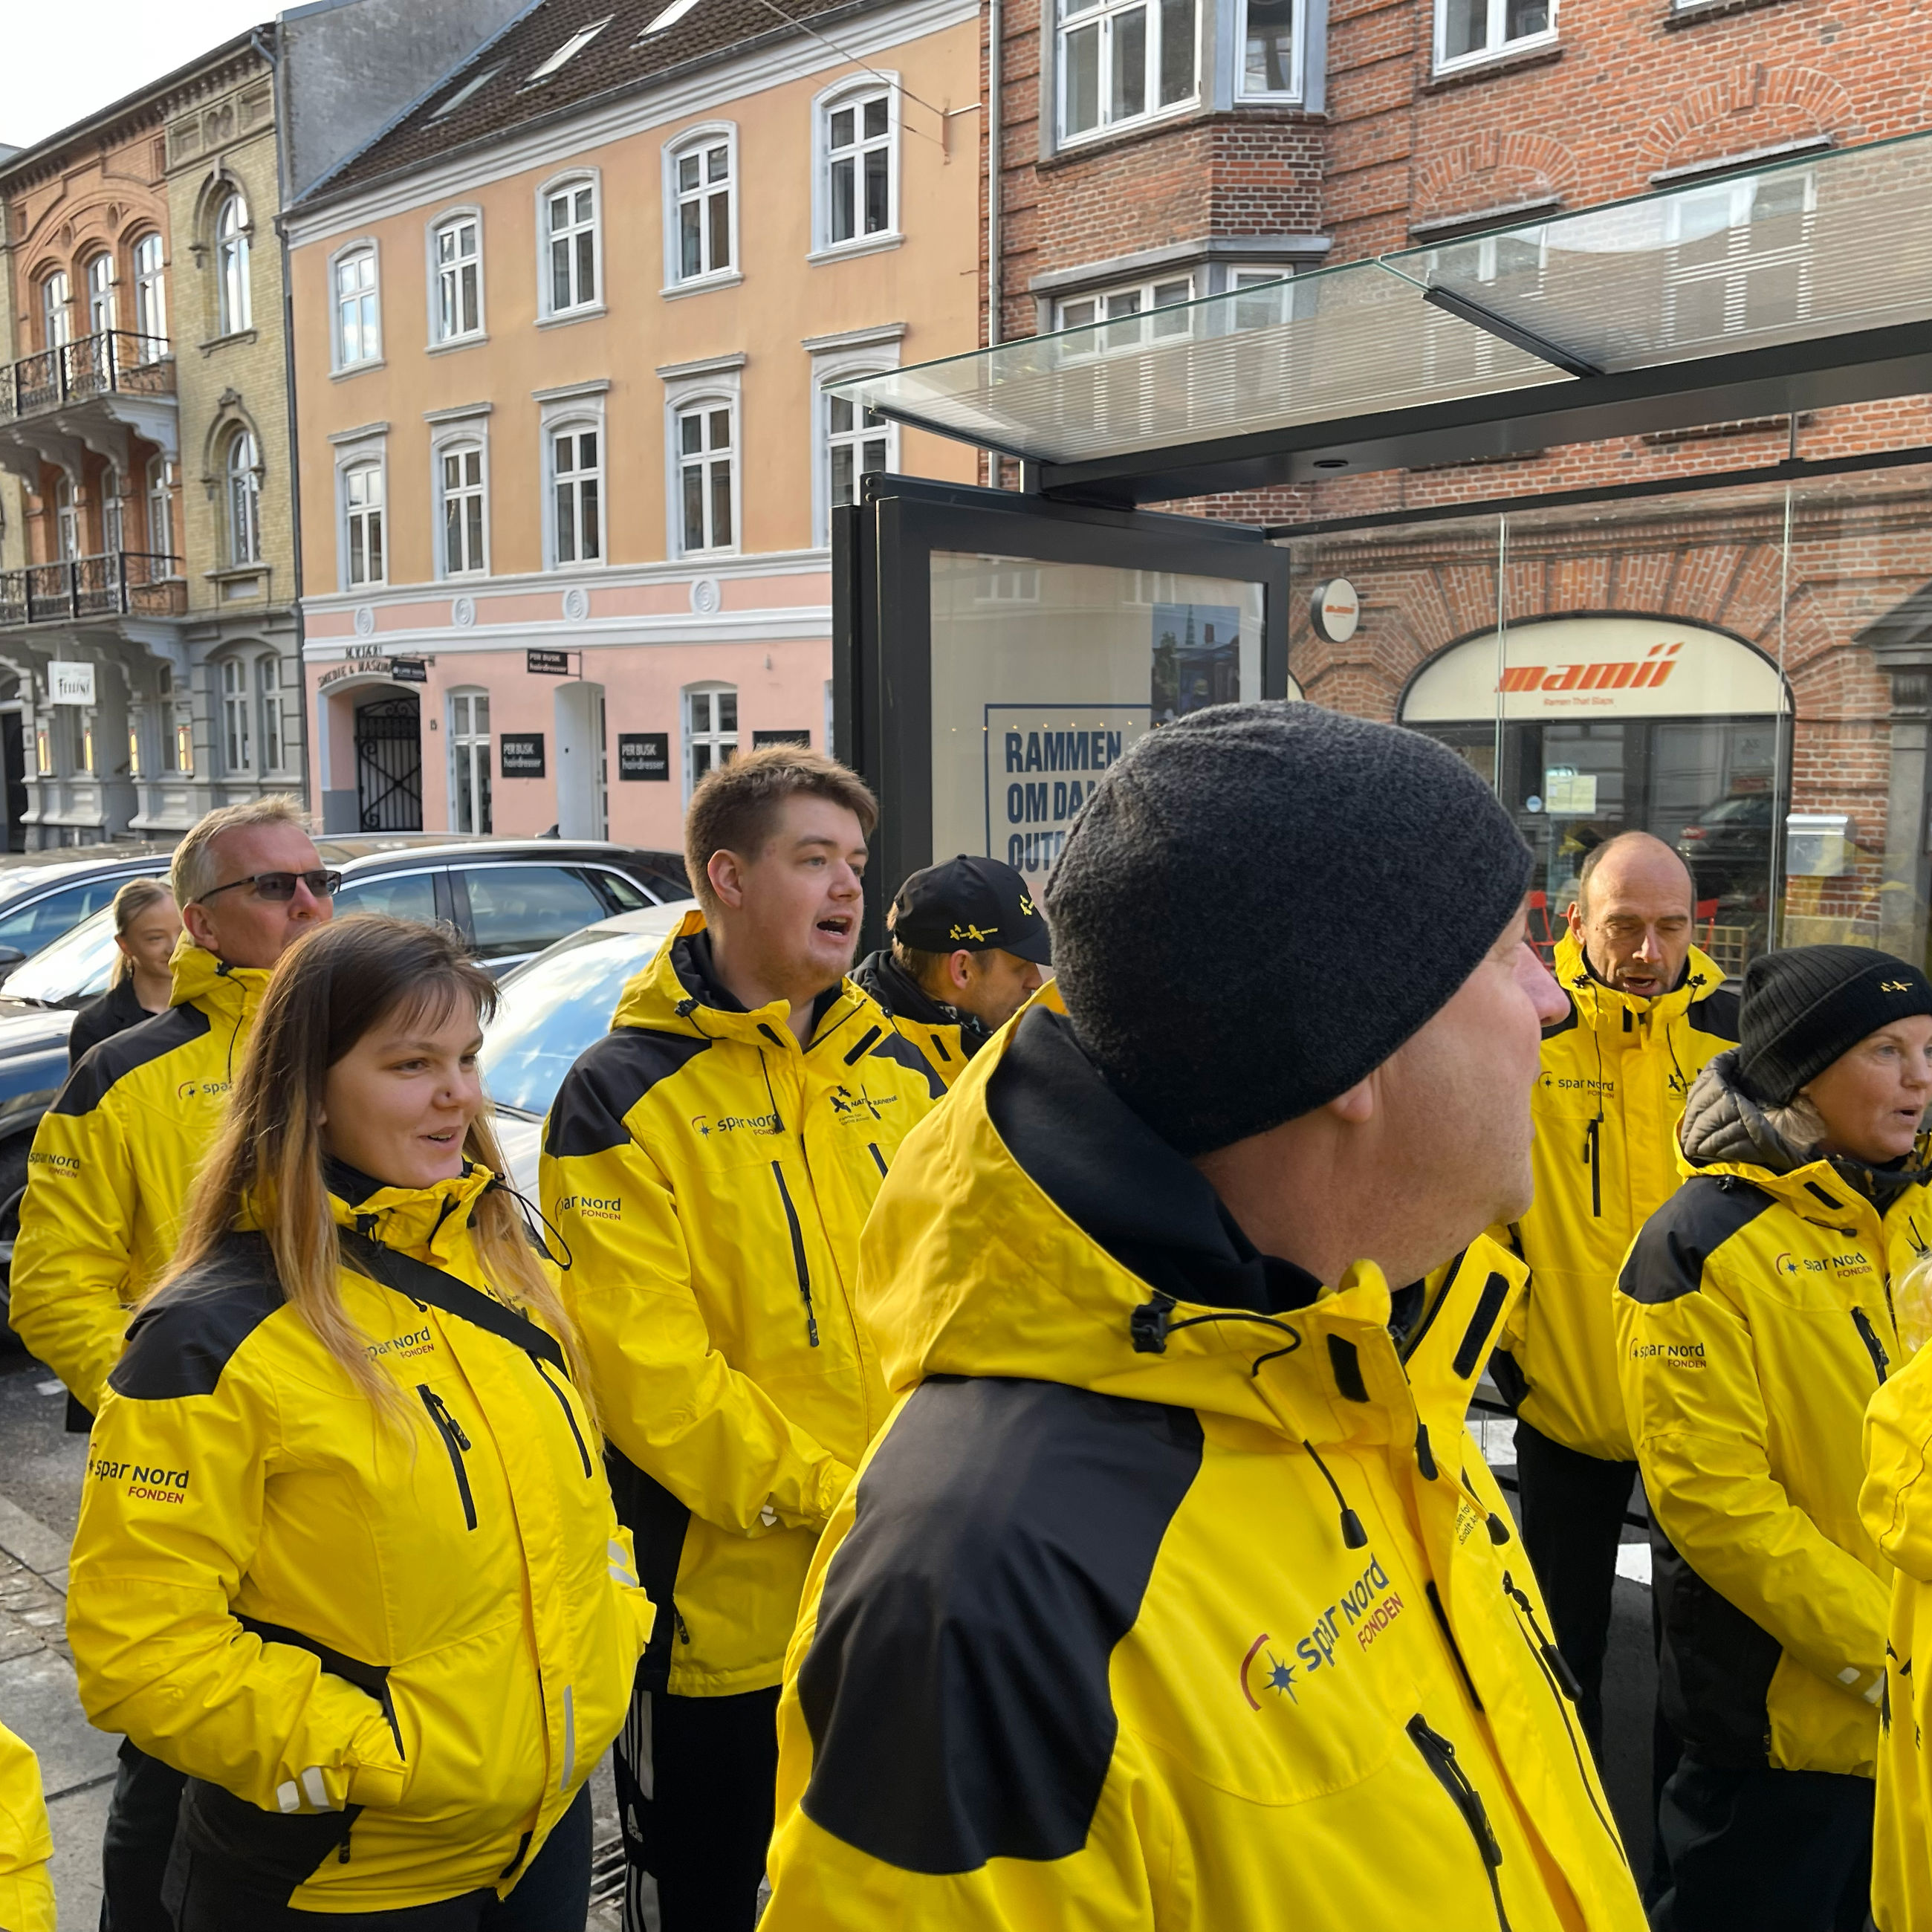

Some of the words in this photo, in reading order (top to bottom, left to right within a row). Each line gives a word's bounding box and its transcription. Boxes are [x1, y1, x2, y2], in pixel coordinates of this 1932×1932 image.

[1494, 642, 1685, 693] mamii
[503, 743, 515, 755] PER
[516, 744, 534, 755] BUSK
[622, 744, 635, 756] PER
[635, 744, 657, 756] BUSK
[1005, 731, 1122, 773] RAMMEN
[503, 756, 541, 768] hairdresser
[622, 757, 665, 770] hairdresser
[1008, 782, 1048, 824] OM
[1054, 780, 1096, 821] DA
[1558, 1079, 1584, 1090] spar
[581, 1210, 621, 1221] FONDEN
[400, 1343, 435, 1358] FONDEN
[1640, 1344, 1665, 1361] spar
[1667, 1359, 1707, 1368] FONDEN
[95, 1459, 132, 1481] spar
[128, 1485, 184, 1505] FONDEN
[1358, 1592, 1404, 1653] FONDEN
